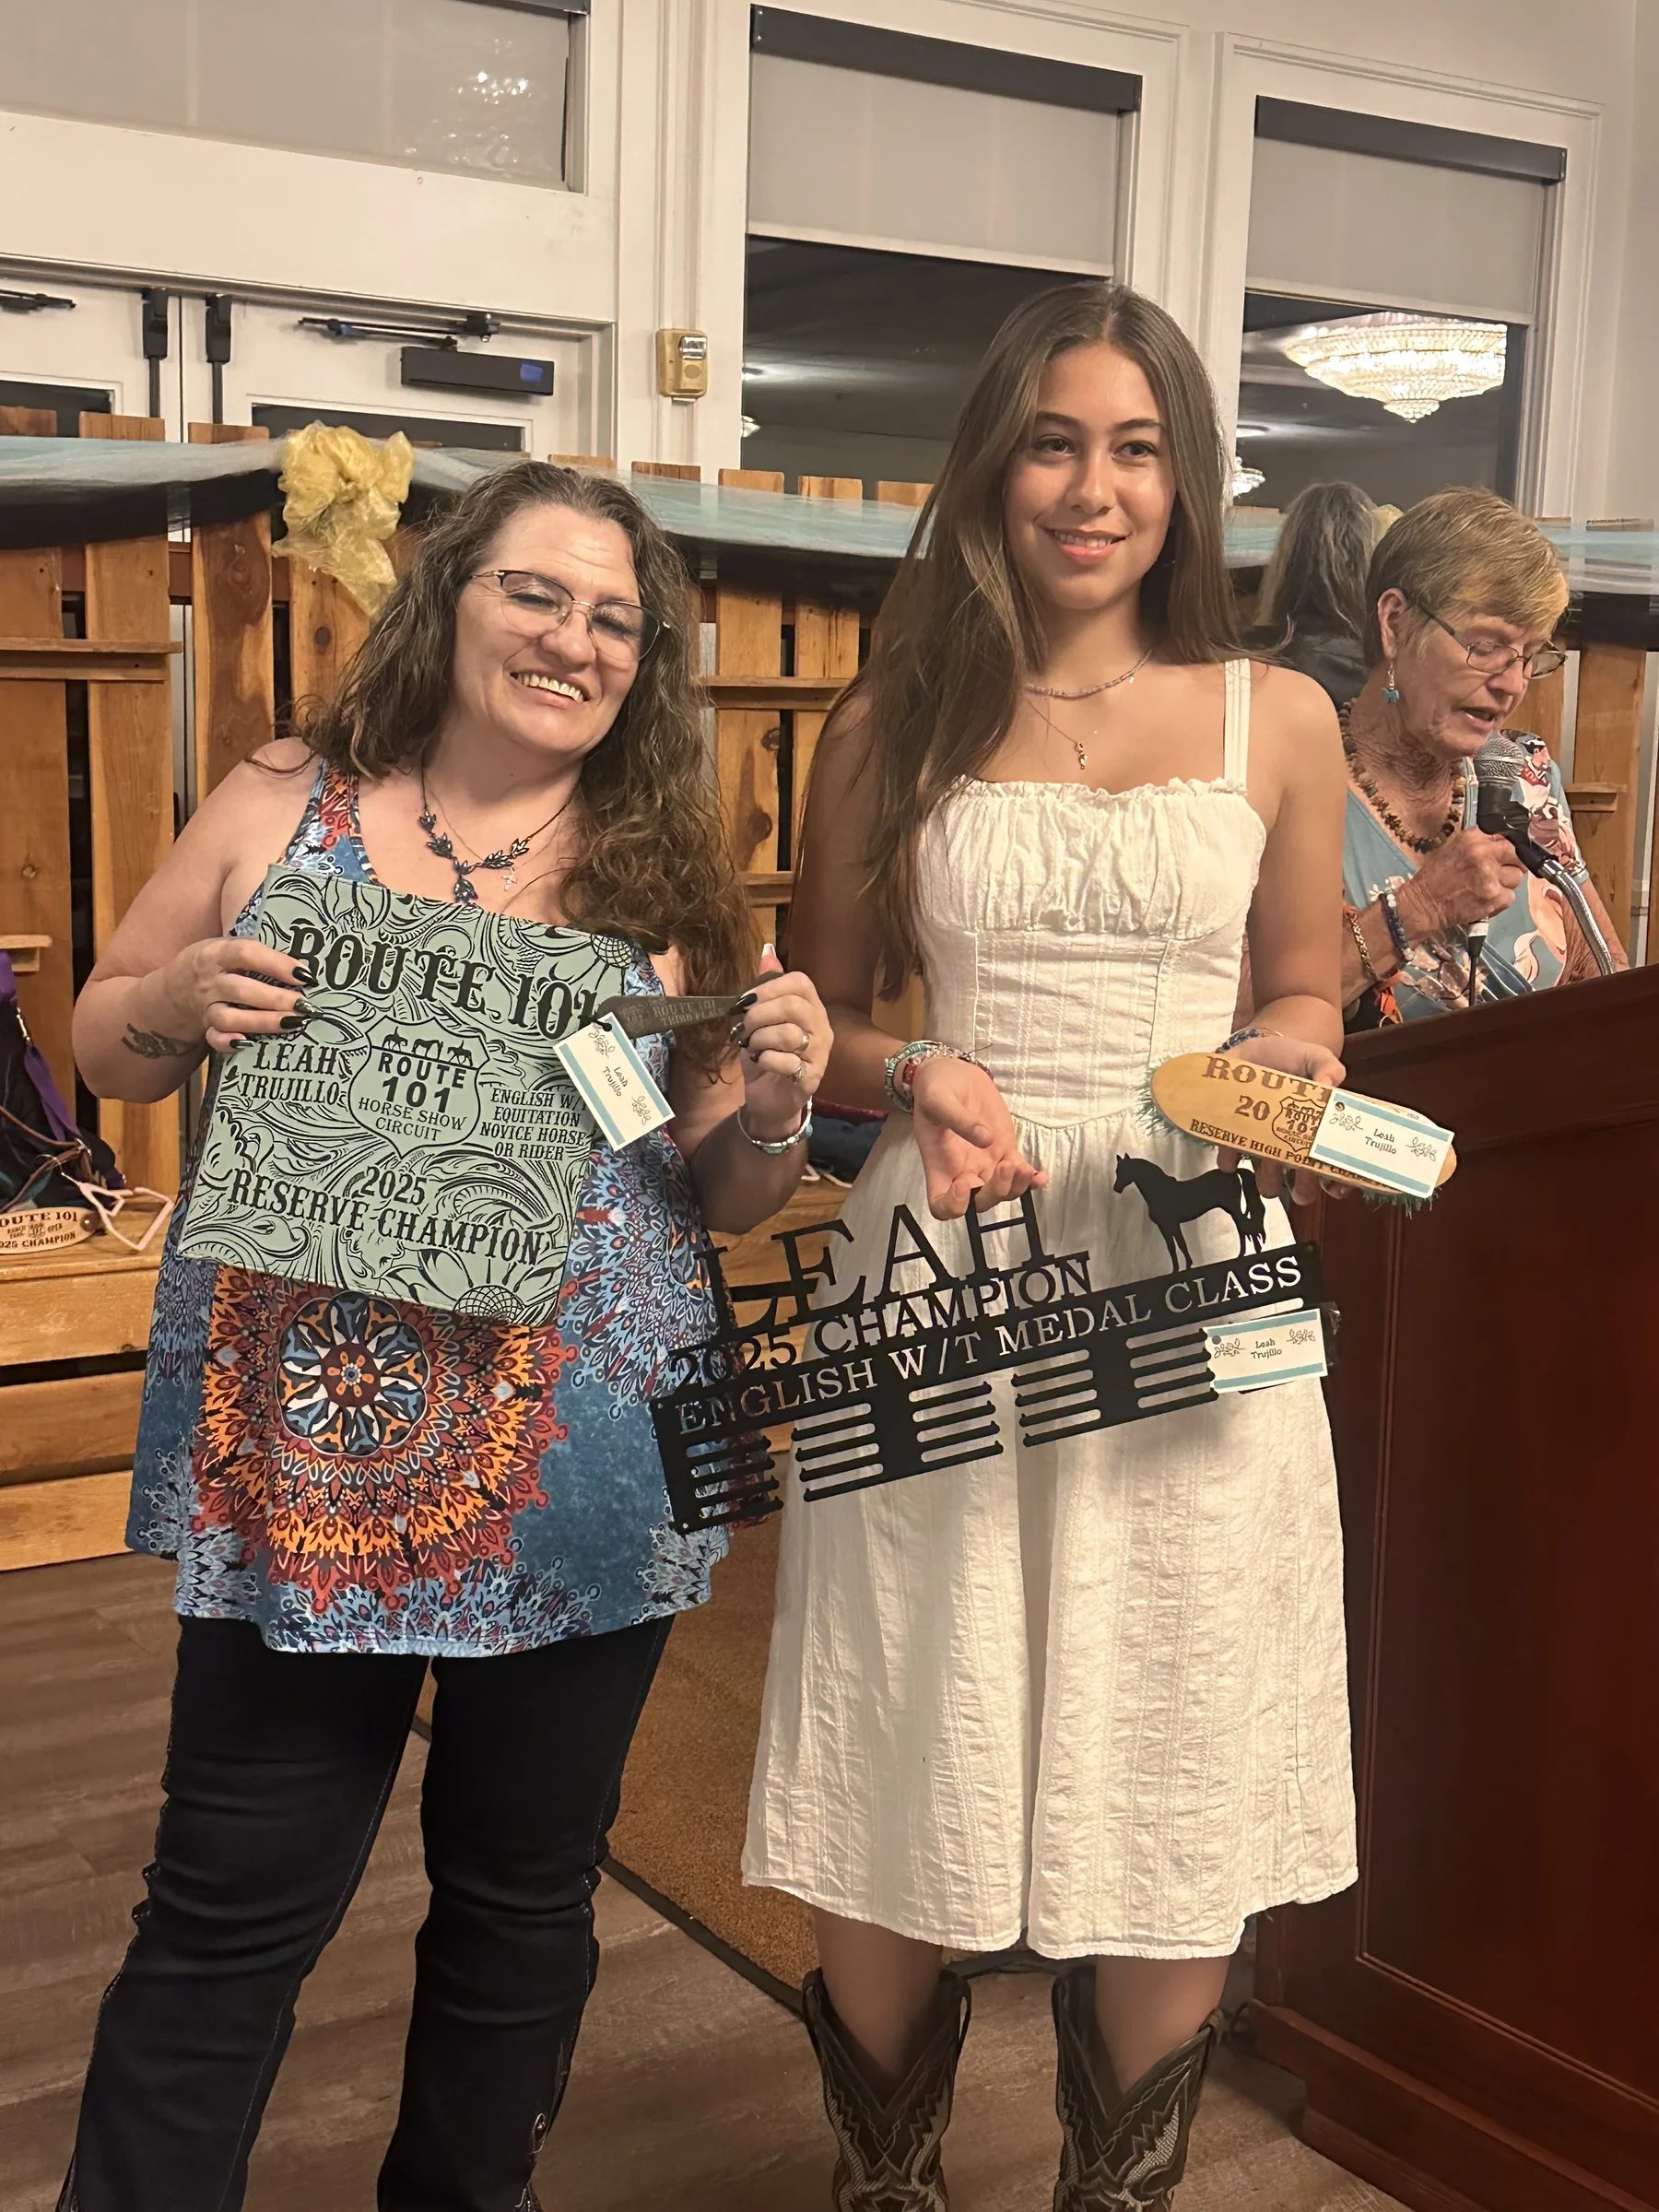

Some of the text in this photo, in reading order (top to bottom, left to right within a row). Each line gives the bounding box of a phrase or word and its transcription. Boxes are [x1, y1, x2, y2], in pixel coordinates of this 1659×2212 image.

[288, 924, 497, 1016] ROUTE
[252, 1040, 341, 1076] LEAH
[378, 1052, 466, 1088] ROUTE
[240, 1073, 340, 1106] TRUJILLO
[602, 1065, 622, 1098] Trujillo
[613, 1066, 629, 1088] Leah
[382, 1076, 451, 1113] 101
[490, 1088, 555, 1108] ENGLISH
[1234, 1095, 1271, 1121] 20
[358, 1097, 468, 1131] HORSE SHOW
[375, 1116, 441, 1142] CIRCUIT
[492, 1105, 581, 1128] EQUITATION
[479, 1121, 587, 1147] NOVICE HORSE
[1189, 1118, 1248, 1147] RESERVE
[1249, 1139, 1282, 1159] HIGH
[1365, 1135, 1397, 1155] Trujillo
[494, 1141, 565, 1161] OR RIDER
[359, 1165, 429, 1206] 2025
[0, 1210, 78, 1228] OUTE 101
[227, 1168, 547, 1266] RESERVE CHAMPION
[0, 1240, 18, 1249] 025
[21, 1230, 76, 1248] CHAMPION
[693, 1186, 1054, 1335] LEAH
[667, 1251, 1090, 1393] 2025 CHAMPION
[677, 1255, 1302, 1435] ENGLISH W/T MEDAL CLASS
[1250, 1347, 1283, 1360] Trujillo
[1254, 1337, 1277, 1349] Leah
